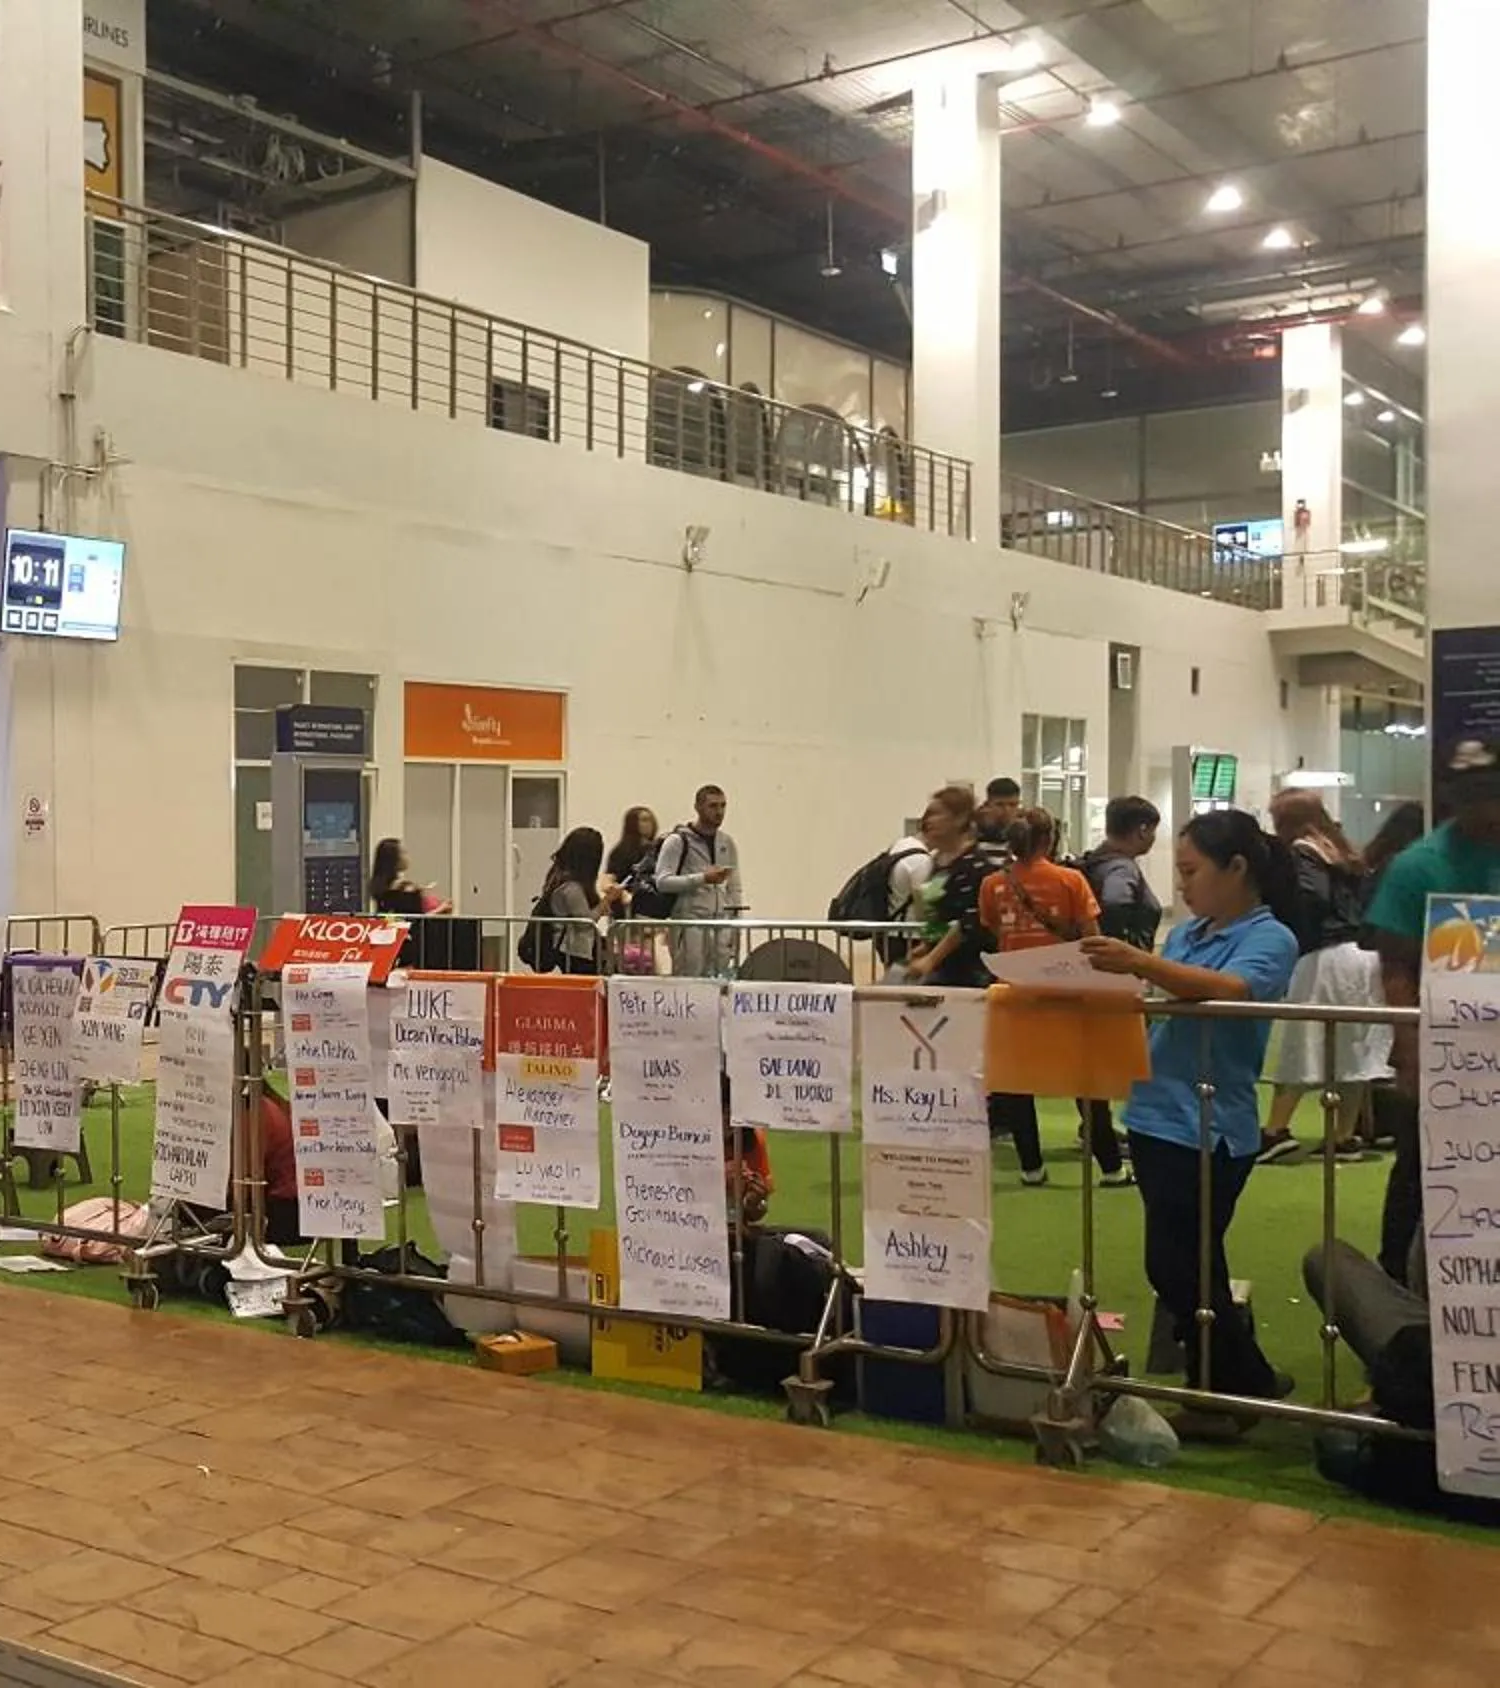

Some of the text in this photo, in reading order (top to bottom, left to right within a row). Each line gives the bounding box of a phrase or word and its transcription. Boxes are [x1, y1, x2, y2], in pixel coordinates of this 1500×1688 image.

[11, 555, 60, 587] 10:11
[164, 977, 232, 1009] CTY
[408, 988, 453, 1020] LUKE
[787, 992, 837, 1014] COHEN
[904, 1086, 936, 1122] Kay
[940, 1087, 957, 1109] Li
[885, 1229, 949, 1273] Ashley
